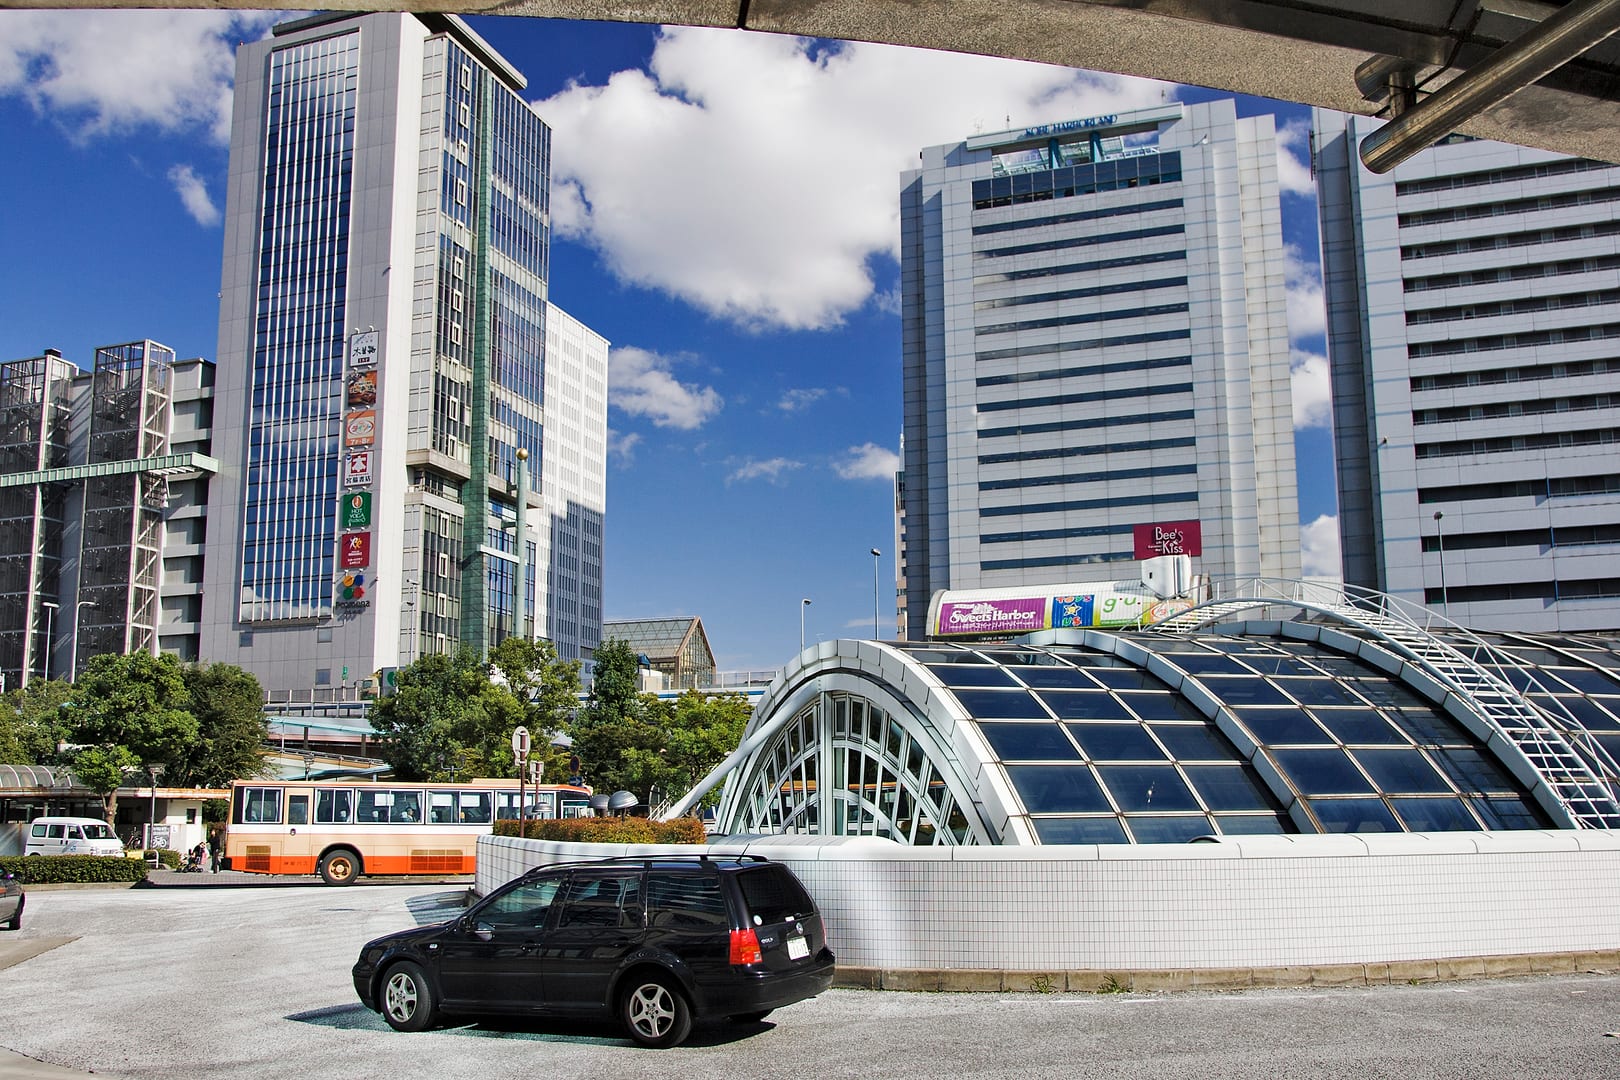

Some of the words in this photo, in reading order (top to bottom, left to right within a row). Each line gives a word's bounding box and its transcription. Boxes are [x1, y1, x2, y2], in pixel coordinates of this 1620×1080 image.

[1024, 125, 1049, 135] KOBE
[1053, 115, 1118, 132] HARBORLAND
[1155, 526, 1184, 543] Bee's
[1162, 540, 1184, 554] Kiss
[1055, 595, 1092, 604] TOYS
[949, 609, 993, 623] Sweets
[993, 607, 1036, 621] Harbor
[1061, 616, 1083, 627] US
